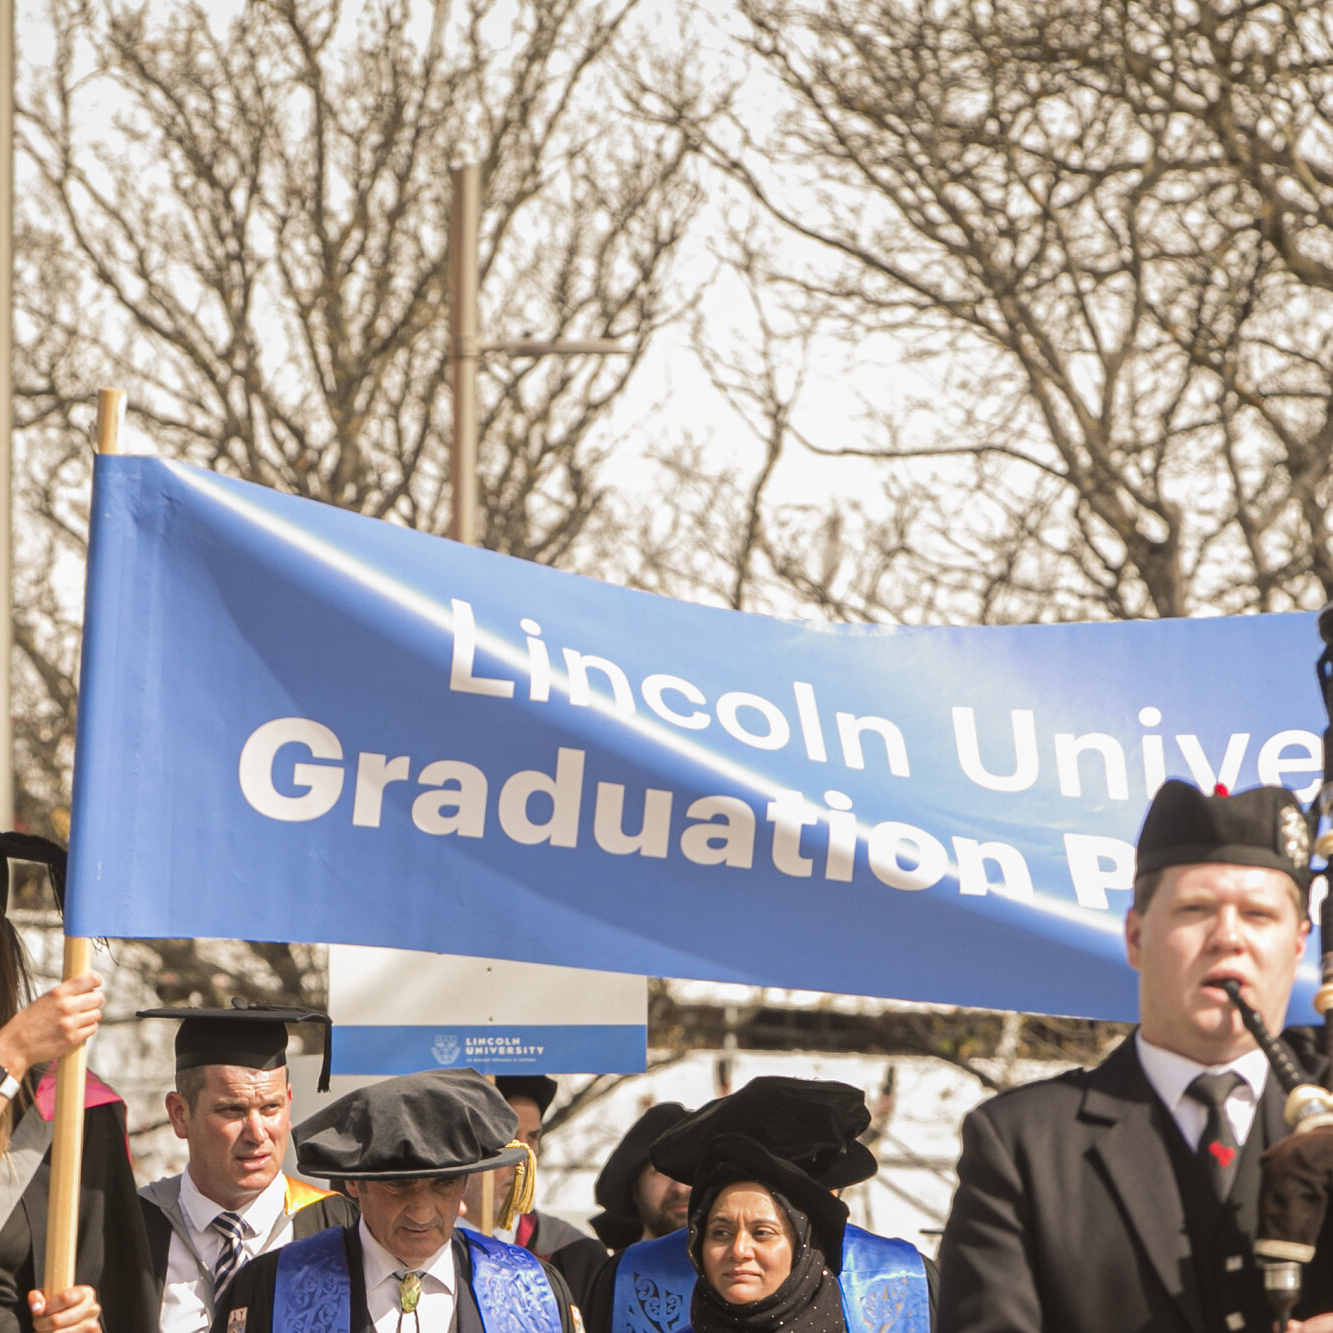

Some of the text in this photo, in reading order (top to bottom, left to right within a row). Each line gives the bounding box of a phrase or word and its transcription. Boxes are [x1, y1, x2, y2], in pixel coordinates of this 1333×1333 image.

[449, 597, 911, 778] Lincoln
[238, 716, 1034, 899] Graduation
[465, 1037, 520, 1045] LINCOLN
[465, 1046, 544, 1054] UNIVERSITY
